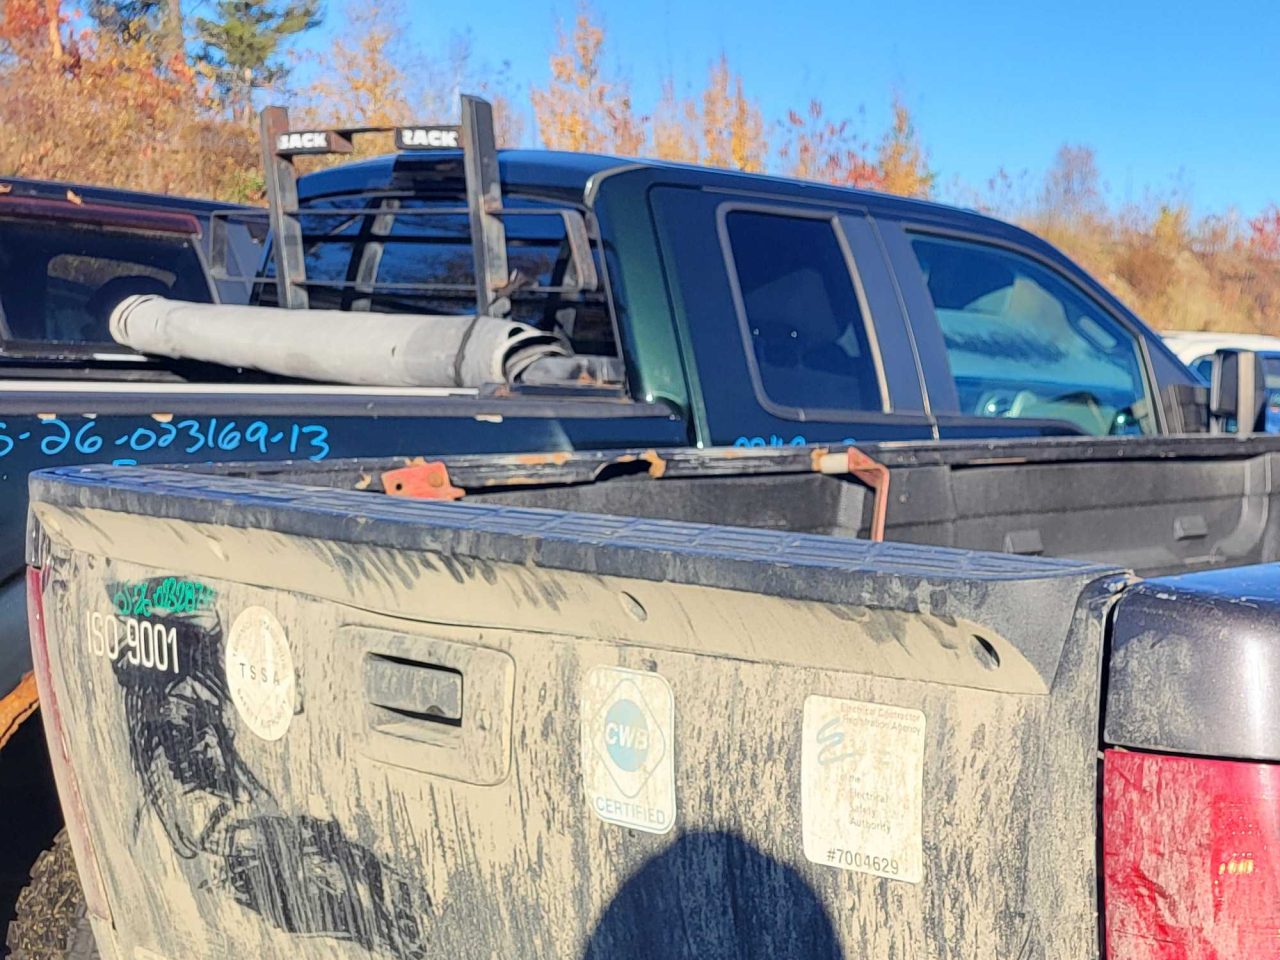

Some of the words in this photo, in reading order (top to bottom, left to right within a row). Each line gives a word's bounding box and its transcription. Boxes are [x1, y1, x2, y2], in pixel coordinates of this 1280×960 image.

[87, 611, 119, 660] ISO
[126, 619, 180, 674] 9001
[604, 721, 649, 751] CWB
[595, 795, 666, 825] CERTIFIED
[826, 847, 900, 875] #7004629
